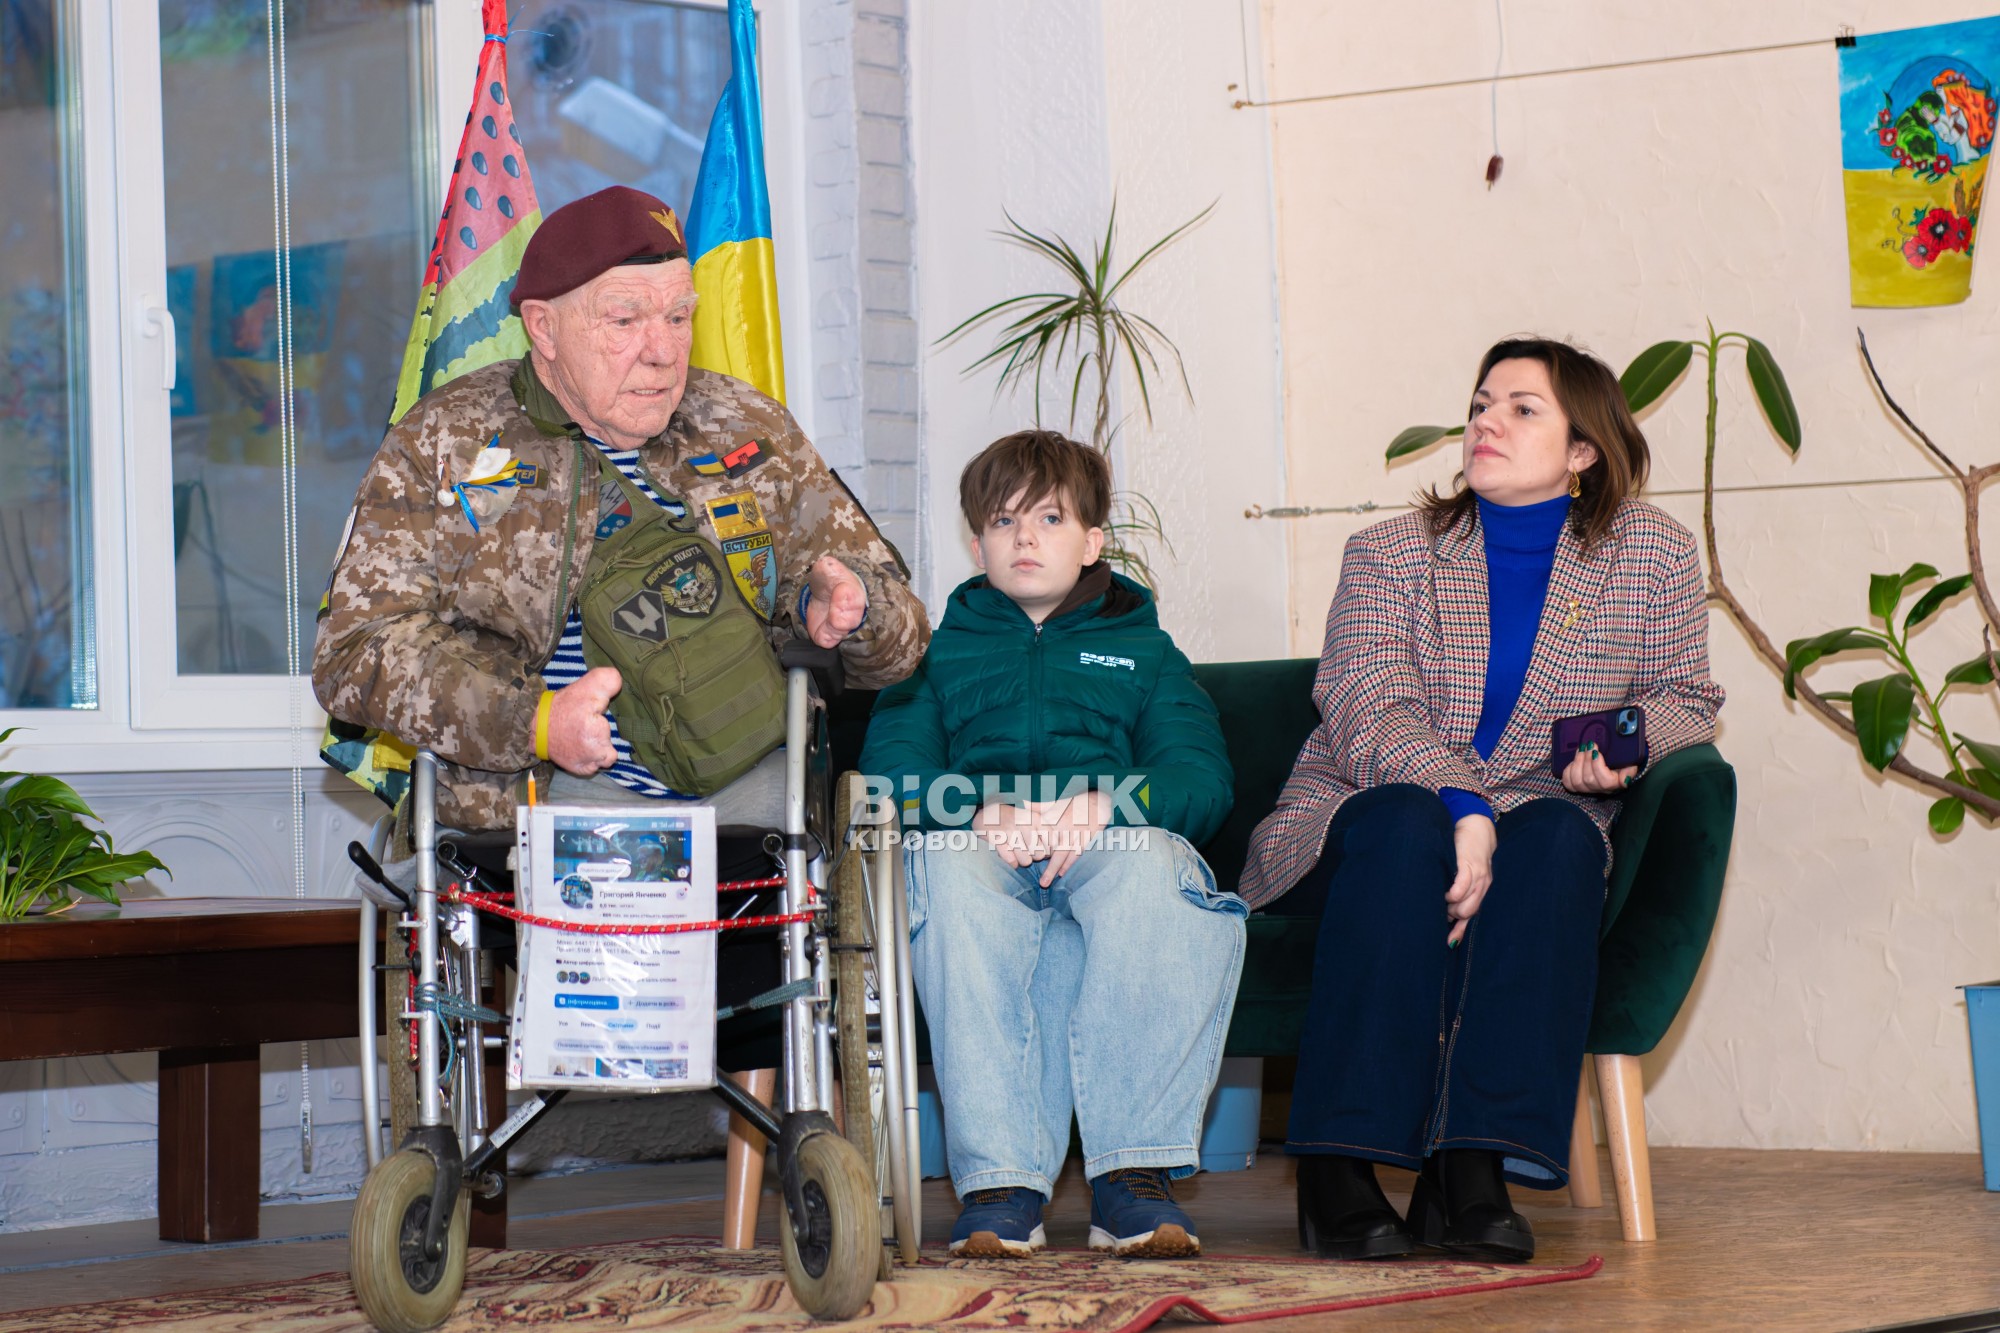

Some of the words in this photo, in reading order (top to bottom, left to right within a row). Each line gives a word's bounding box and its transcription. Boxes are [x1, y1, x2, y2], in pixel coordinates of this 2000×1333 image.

[516, 468, 535, 479] ТЕР
[725, 535, 770, 553] ЯСТРУБИ
[646, 558, 676, 586] МОРСЬКА
[673, 546, 702, 563] ПІХОТА
[600, 891, 634, 900] Григорий
[635, 891, 667, 899] Янченко
